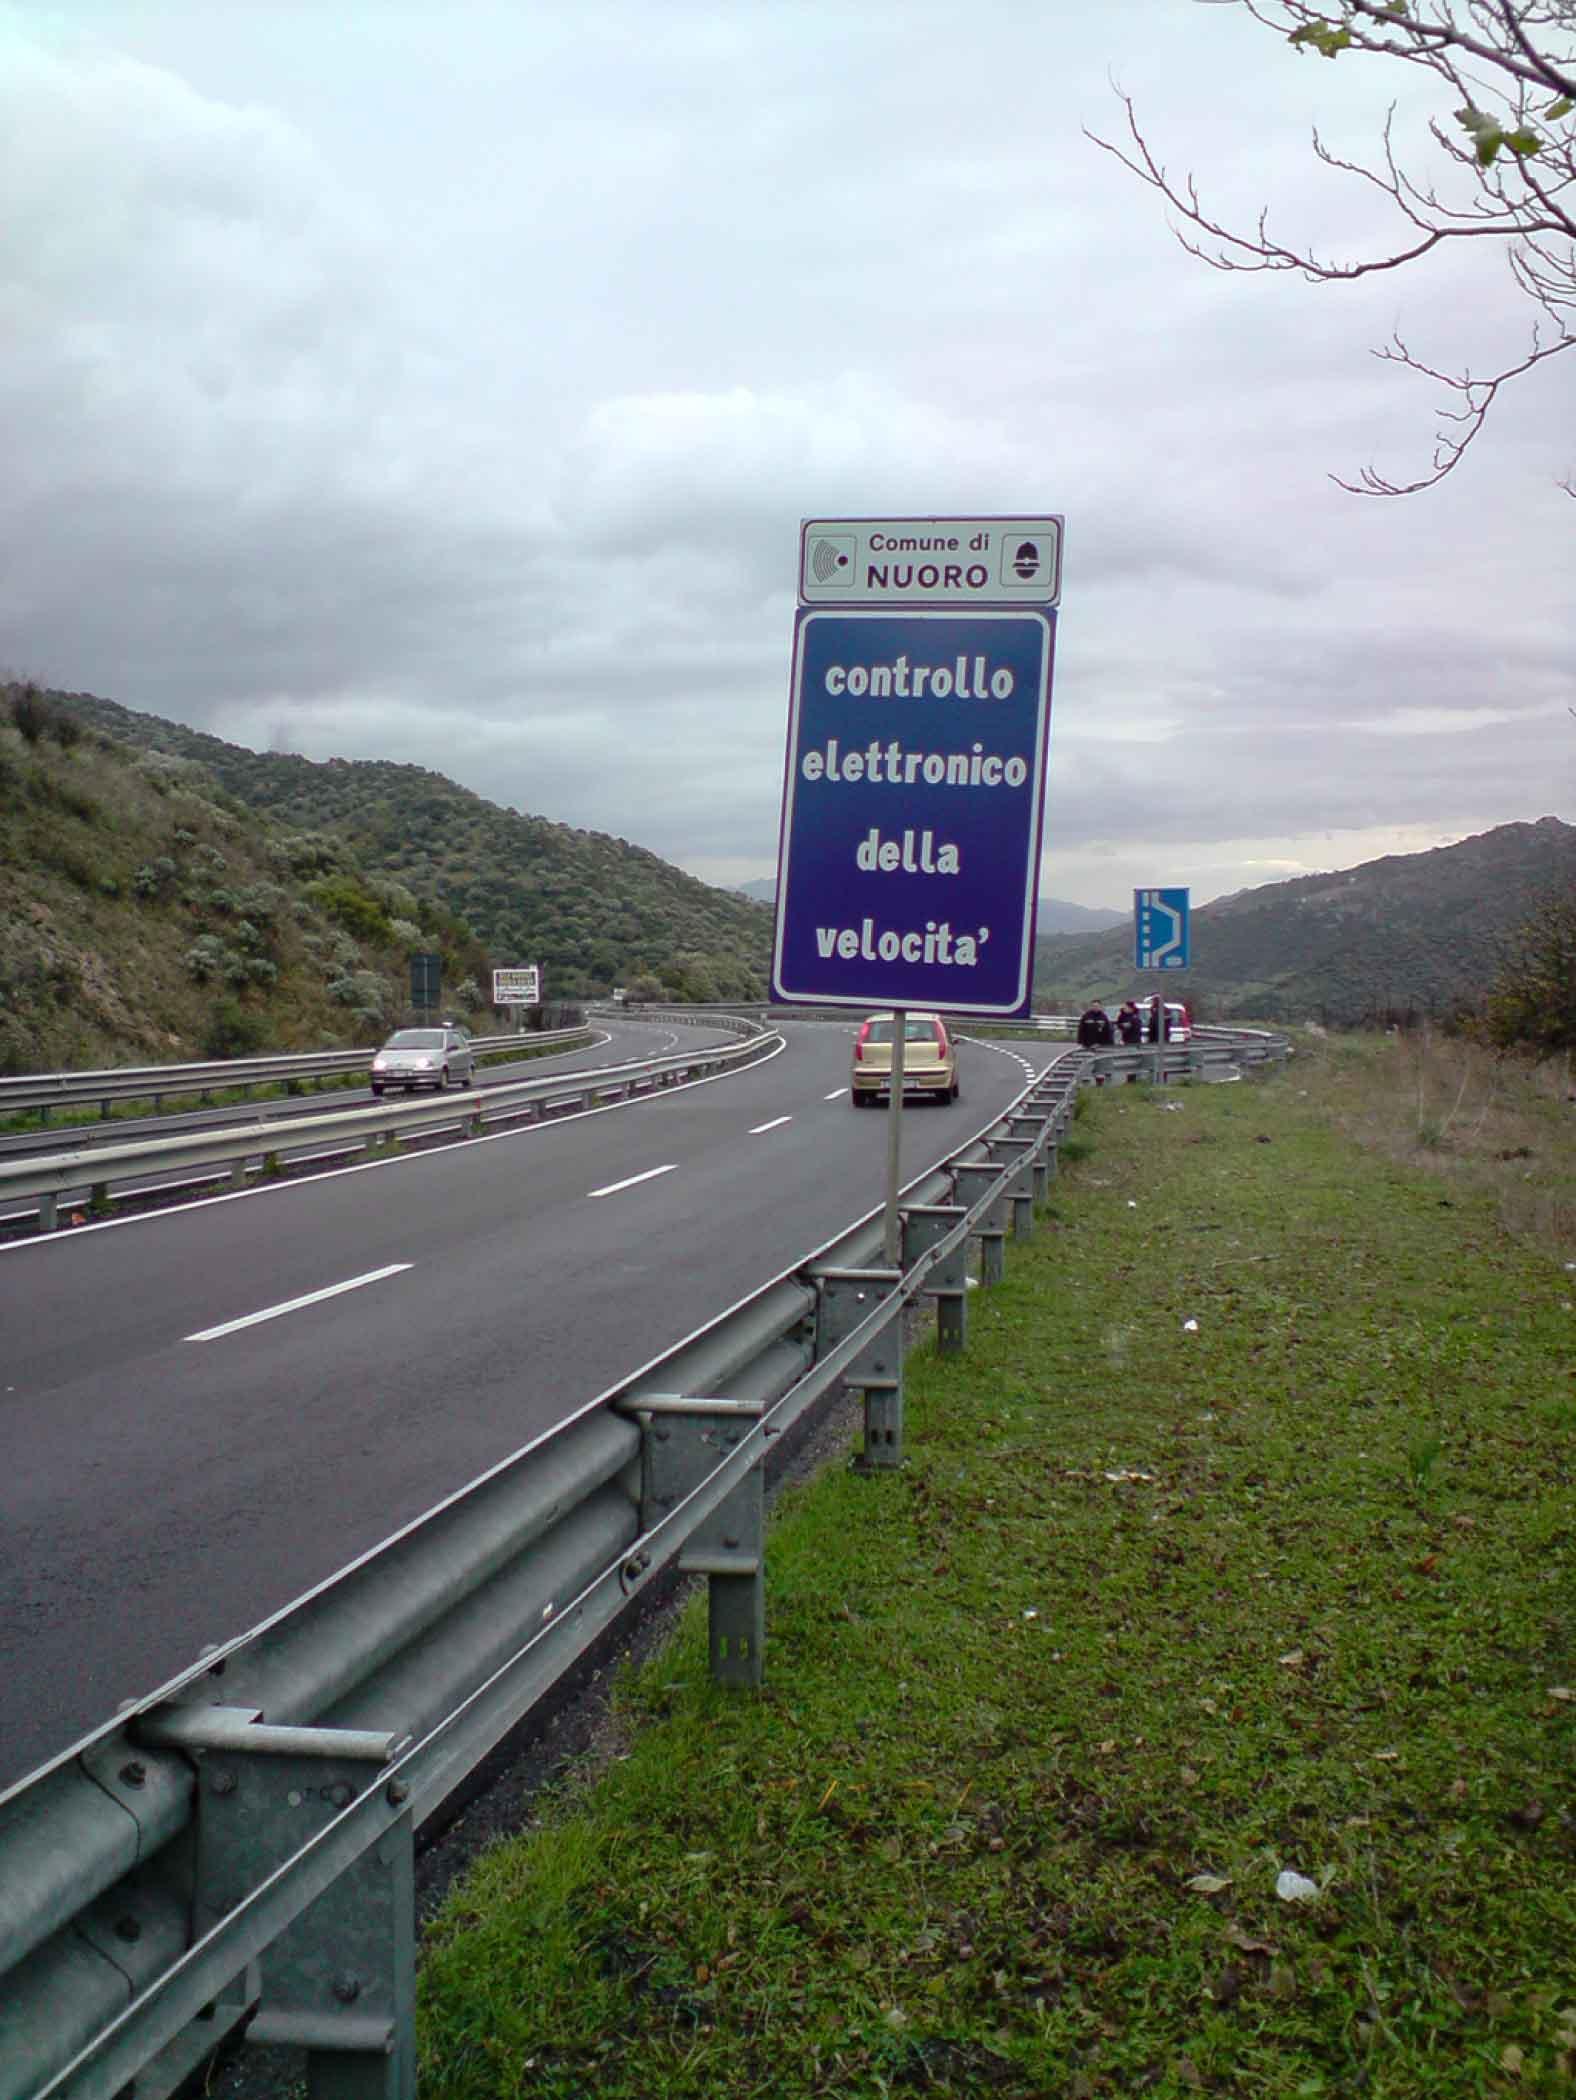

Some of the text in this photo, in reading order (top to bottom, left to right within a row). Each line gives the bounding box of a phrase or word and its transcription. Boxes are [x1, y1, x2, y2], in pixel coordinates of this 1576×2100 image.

[869, 533, 989, 552] Comune di
[867, 565, 988, 588] NUORO
[825, 656, 1013, 699] controllo
[802, 740, 1027, 787] elettronico
[857, 829, 959, 874] della
